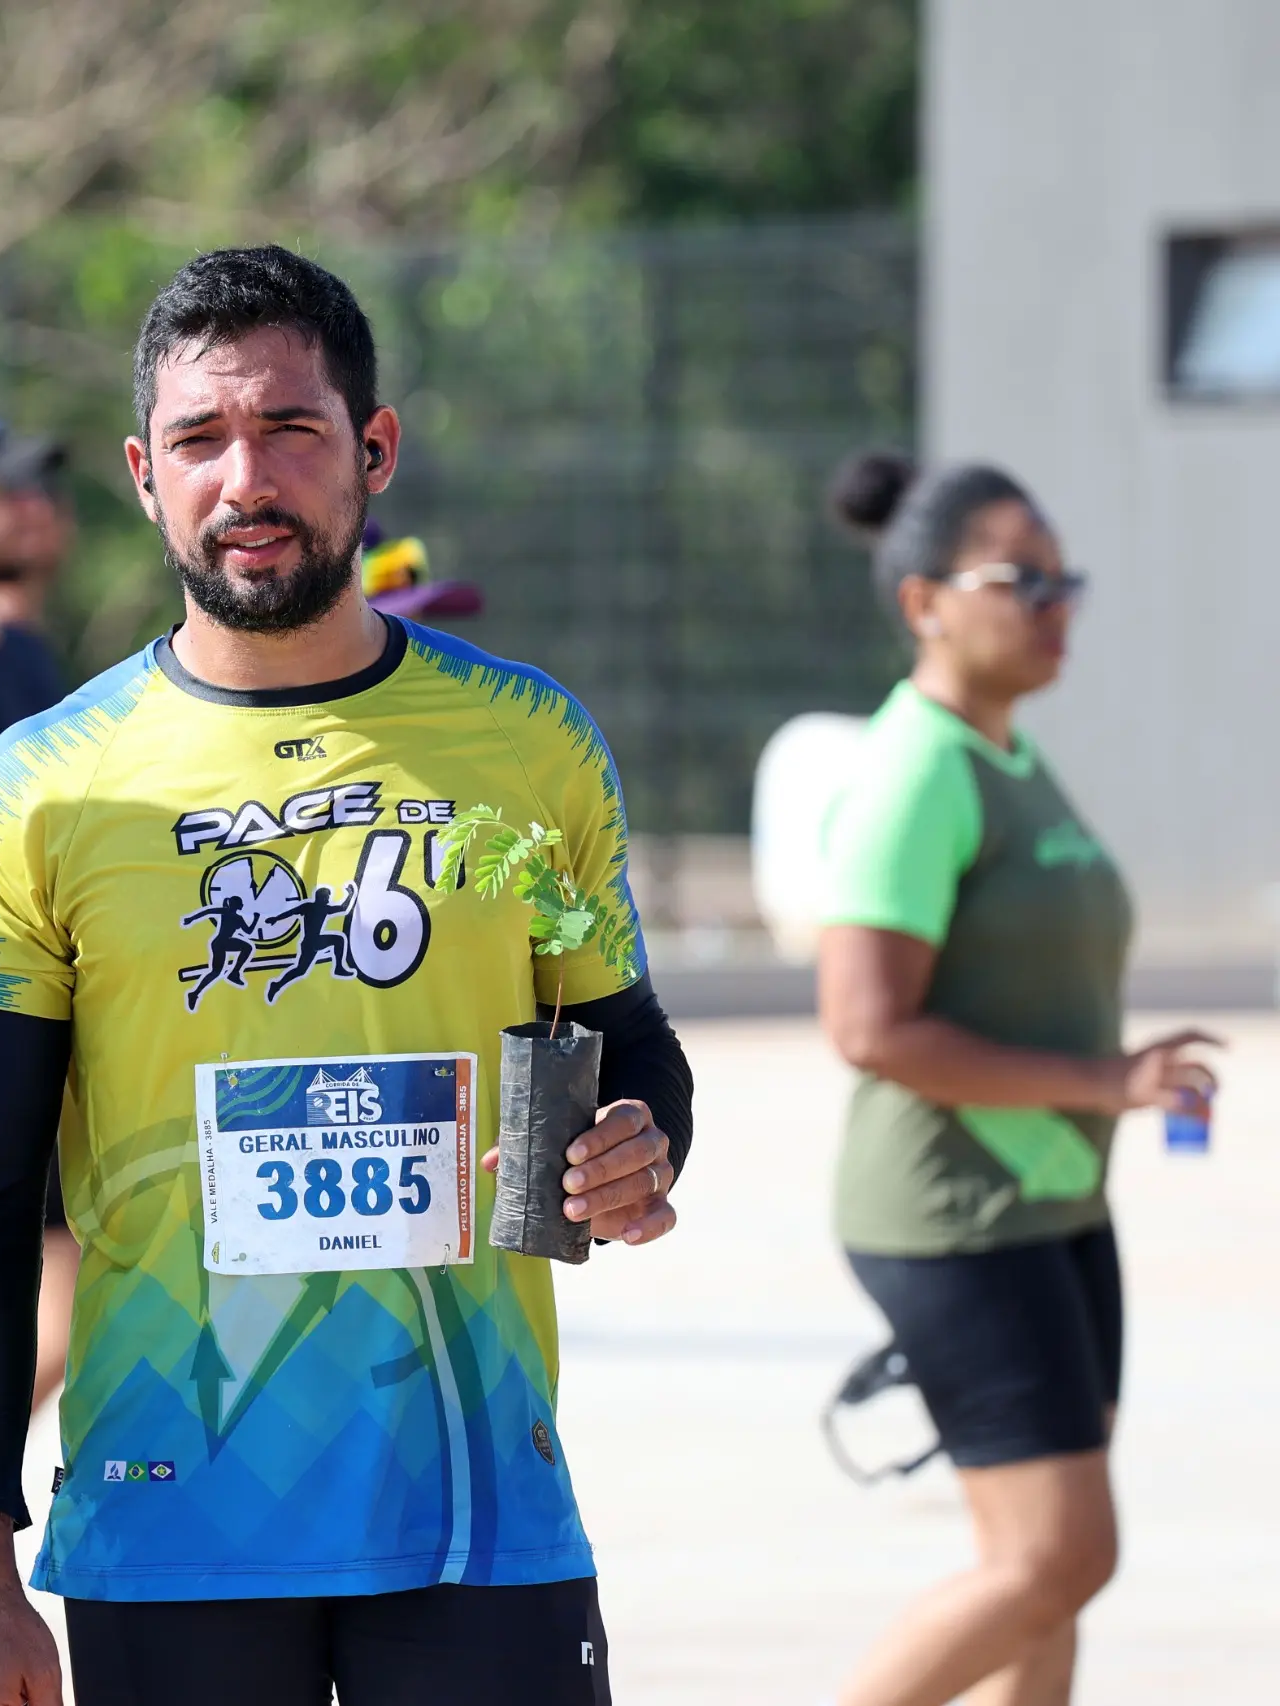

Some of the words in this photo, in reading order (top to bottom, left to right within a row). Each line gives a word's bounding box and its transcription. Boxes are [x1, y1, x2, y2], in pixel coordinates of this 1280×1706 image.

[273, 736, 327, 759] GTX
[171, 782, 384, 855] PACE
[395, 799, 457, 825] DE
[459, 1085, 468, 1112] 3885
[204, 1119, 213, 1141] 3885
[239, 1132, 313, 1154] GERAL
[321, 1127, 440, 1150] MASCULINO
[459, 1123, 468, 1175] LARANJA
[206, 1148, 217, 1196] MEDALHA
[255, 1155, 432, 1221] 3885
[210, 1198, 218, 1224] VALE
[459, 1178, 468, 1232] PELOTAO
[319, 1234, 382, 1250] DANIEL
